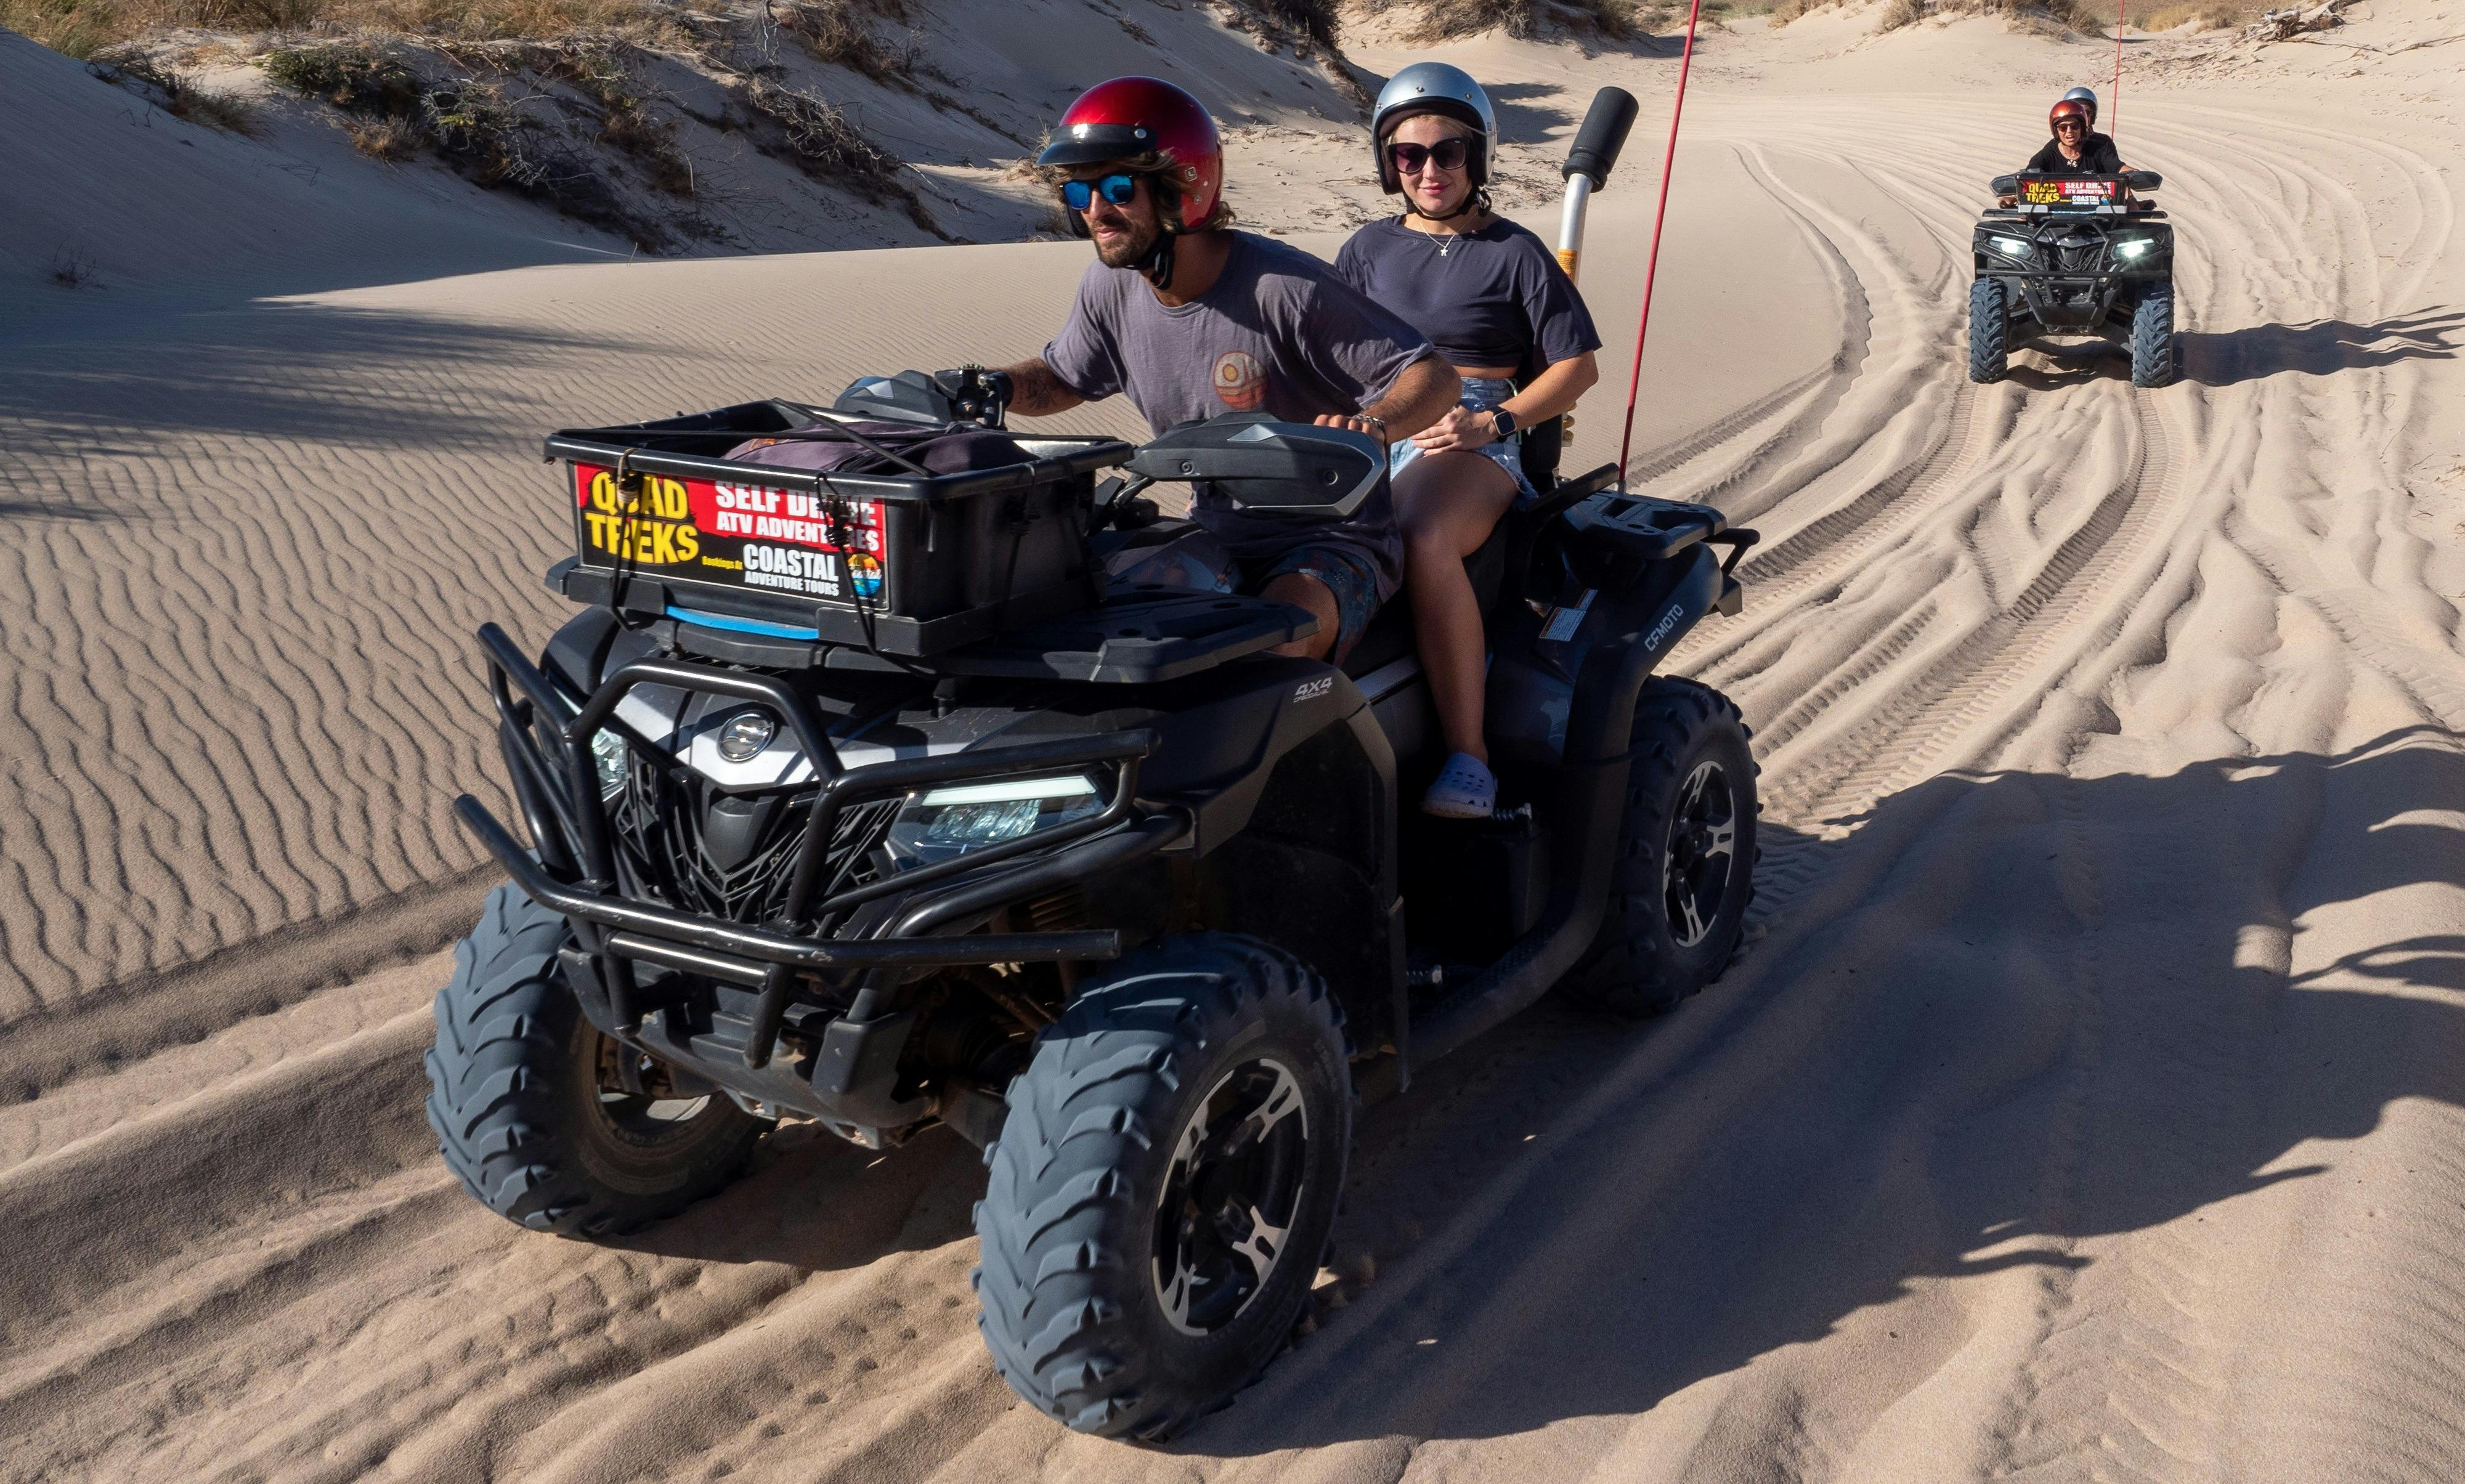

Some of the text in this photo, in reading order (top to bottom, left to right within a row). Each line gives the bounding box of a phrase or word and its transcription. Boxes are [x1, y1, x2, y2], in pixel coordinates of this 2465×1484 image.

[2025, 192, 2060, 203] TREKS
[715, 480, 877, 527] SELF DRVE
[585, 512, 699, 564] TREKS
[717, 511, 879, 552] ATV ADVENTRES
[743, 543, 839, 582] COASTAL
[744, 570, 840, 597] ADVENTURE TOURS
[1644, 604, 1684, 651] CFMOTO
